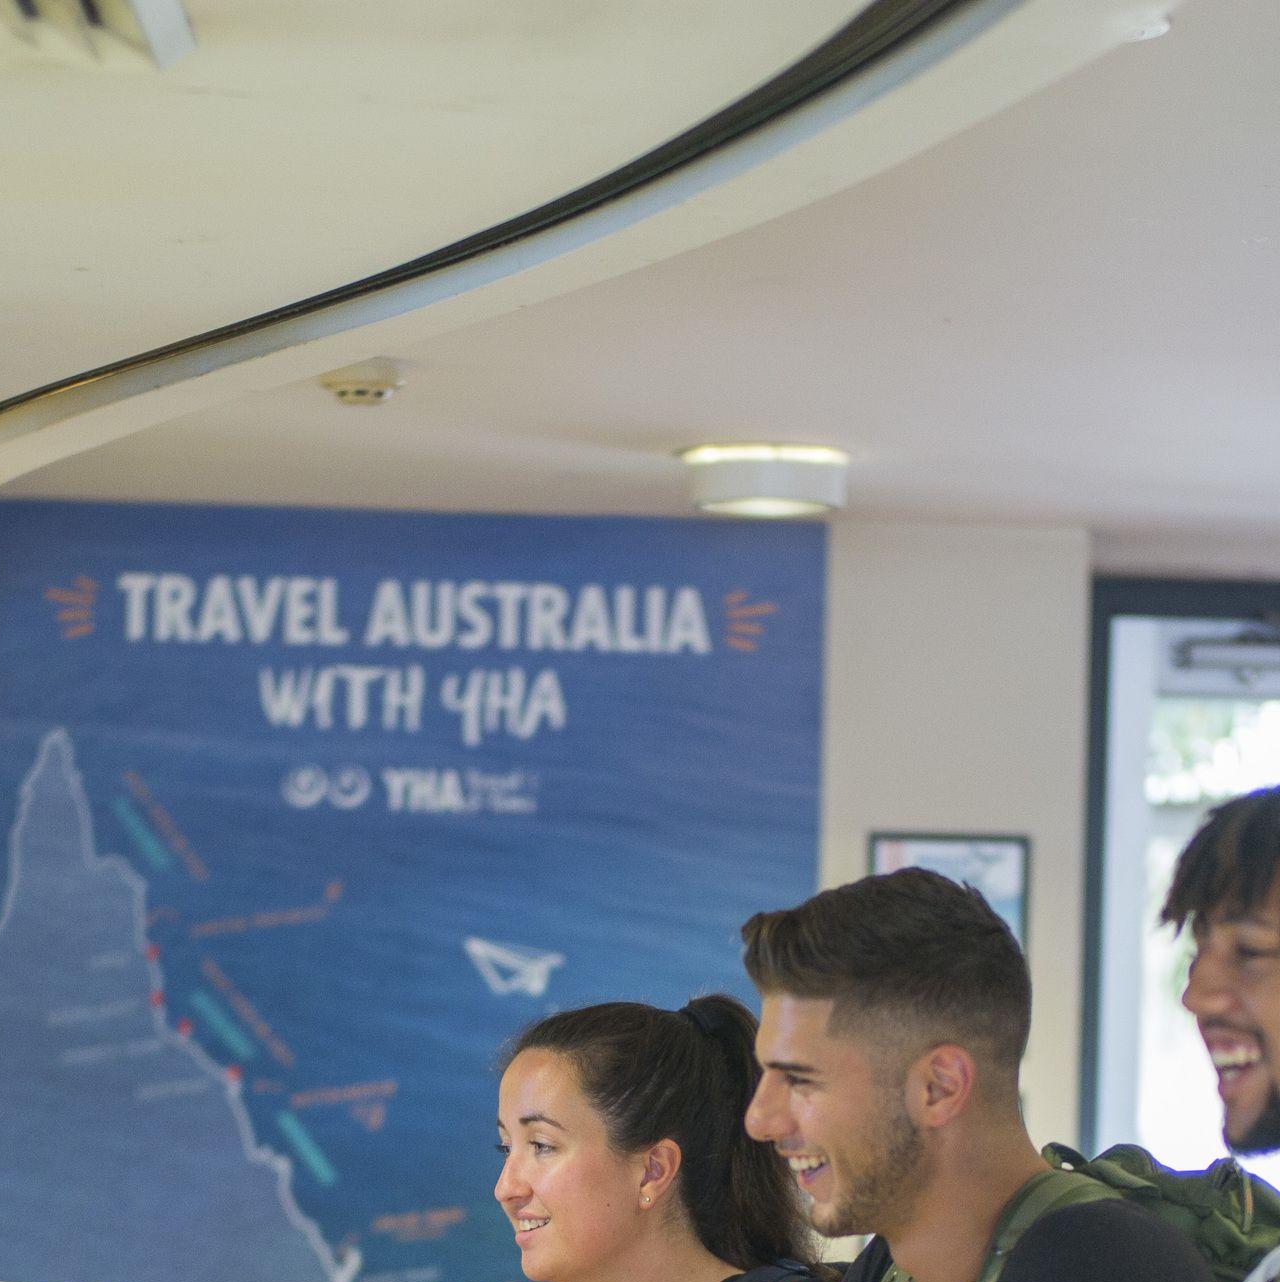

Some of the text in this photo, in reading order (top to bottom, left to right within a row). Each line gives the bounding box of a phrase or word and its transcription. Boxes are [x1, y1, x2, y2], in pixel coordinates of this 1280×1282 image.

[118, 573, 712, 653] TRAVEL AUSTRALIA
[258, 666, 566, 747] WITH YHA
